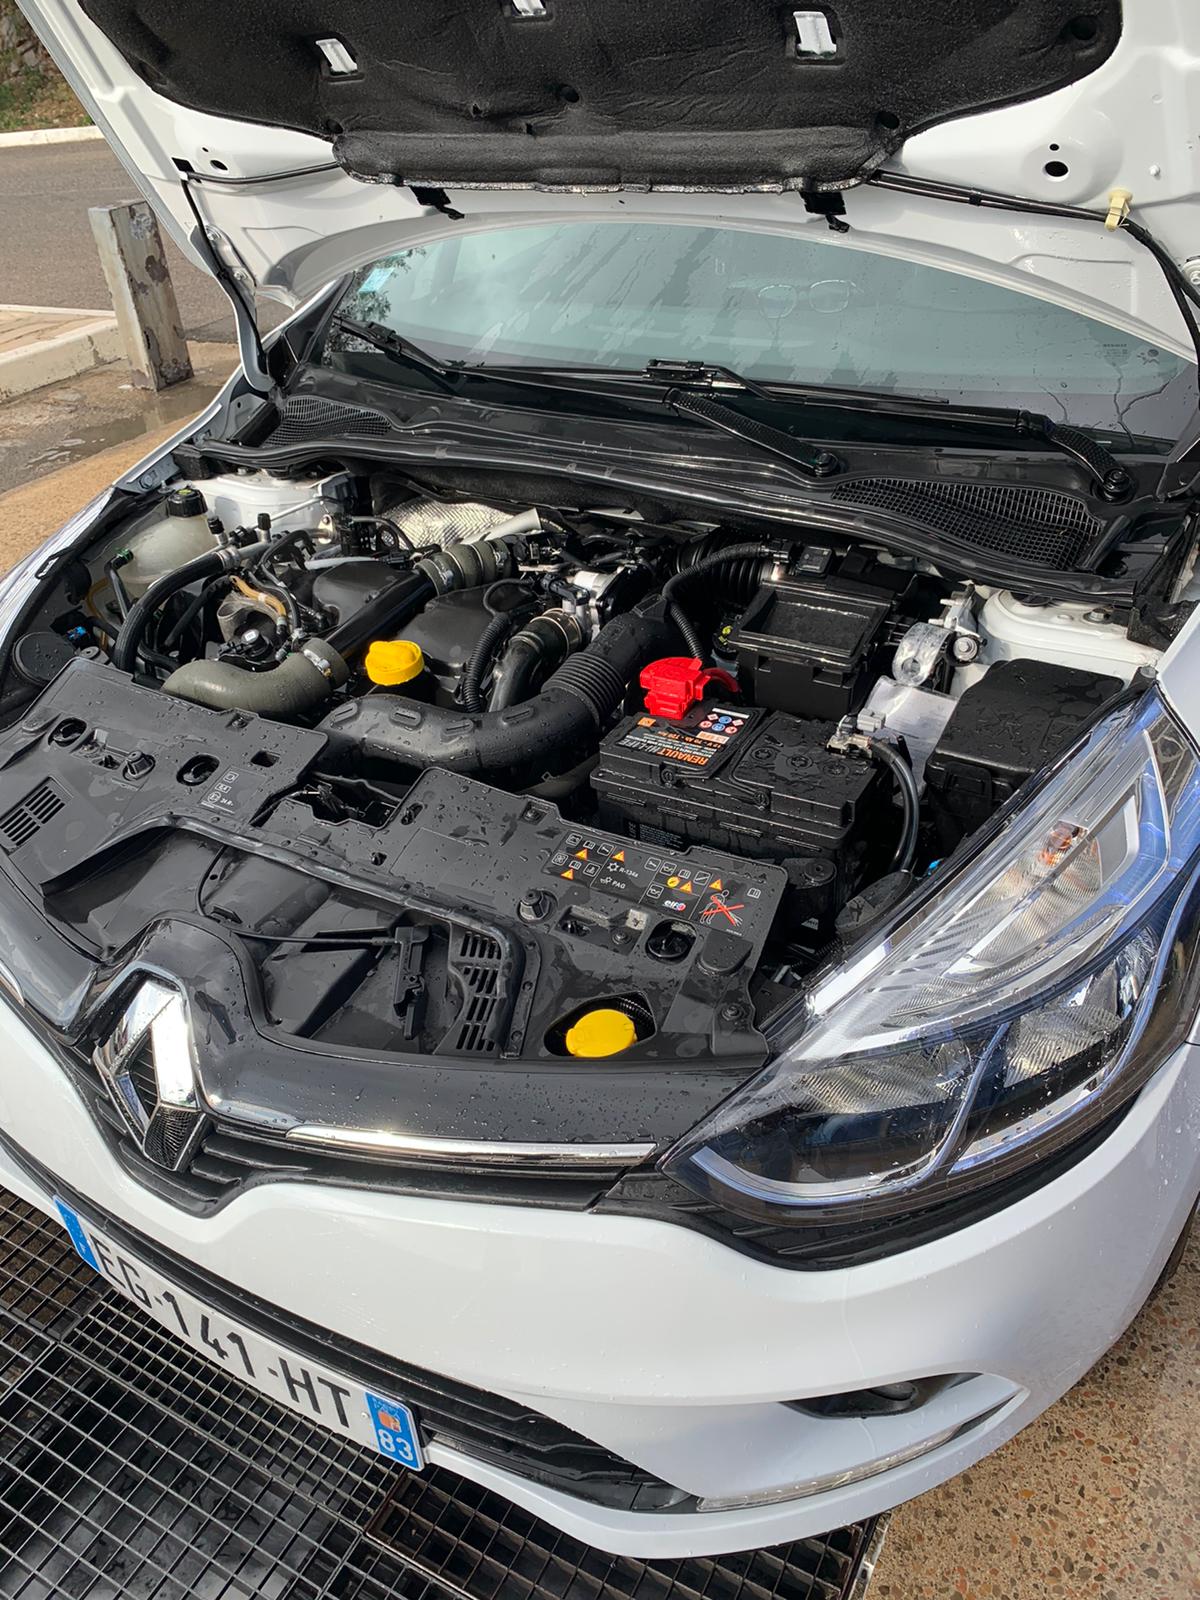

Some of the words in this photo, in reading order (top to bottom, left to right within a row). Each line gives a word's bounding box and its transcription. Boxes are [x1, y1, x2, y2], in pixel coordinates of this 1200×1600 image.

[656, 747, 709, 766] RENAULT
[90, 1233, 351, 1428] EG-141-HT
[378, 1429, 413, 1461] 83
